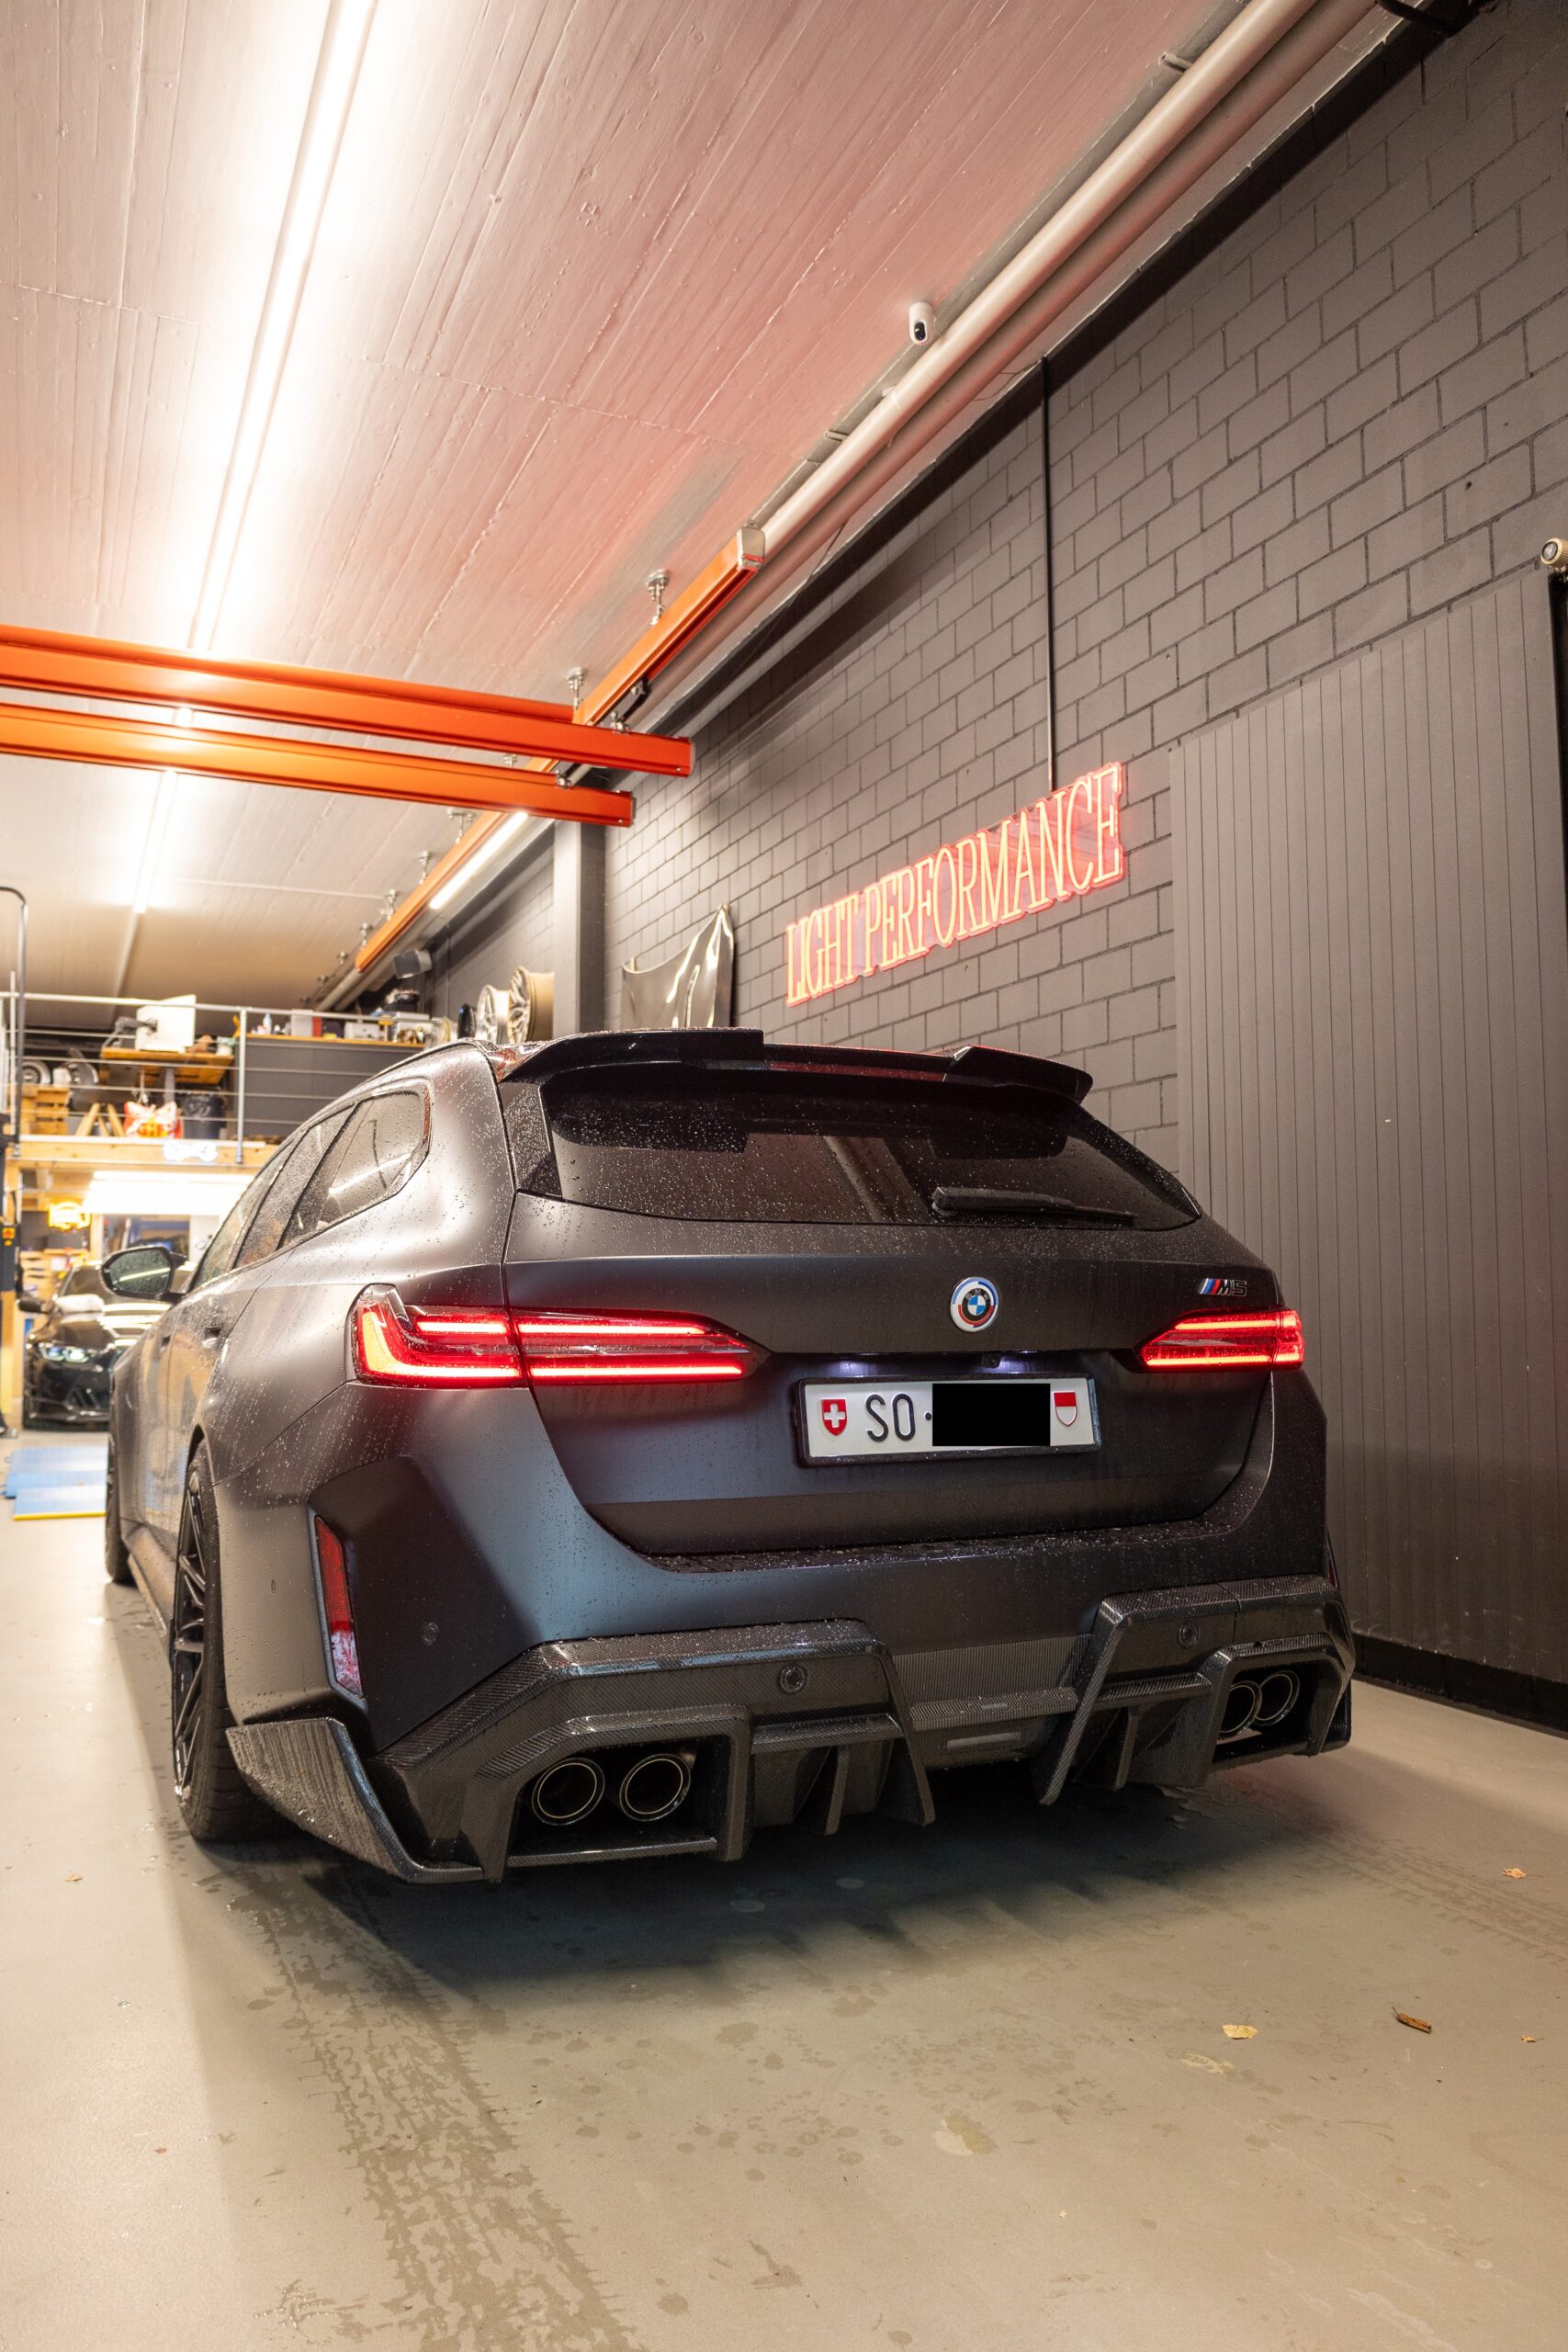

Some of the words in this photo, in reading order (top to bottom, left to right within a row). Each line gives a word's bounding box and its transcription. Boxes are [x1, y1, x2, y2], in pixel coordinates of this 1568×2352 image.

[786, 892, 860, 1006] LIGHT
[863, 763, 1124, 975] PERFORMANCE
[1216, 1278, 1247, 1296] M5
